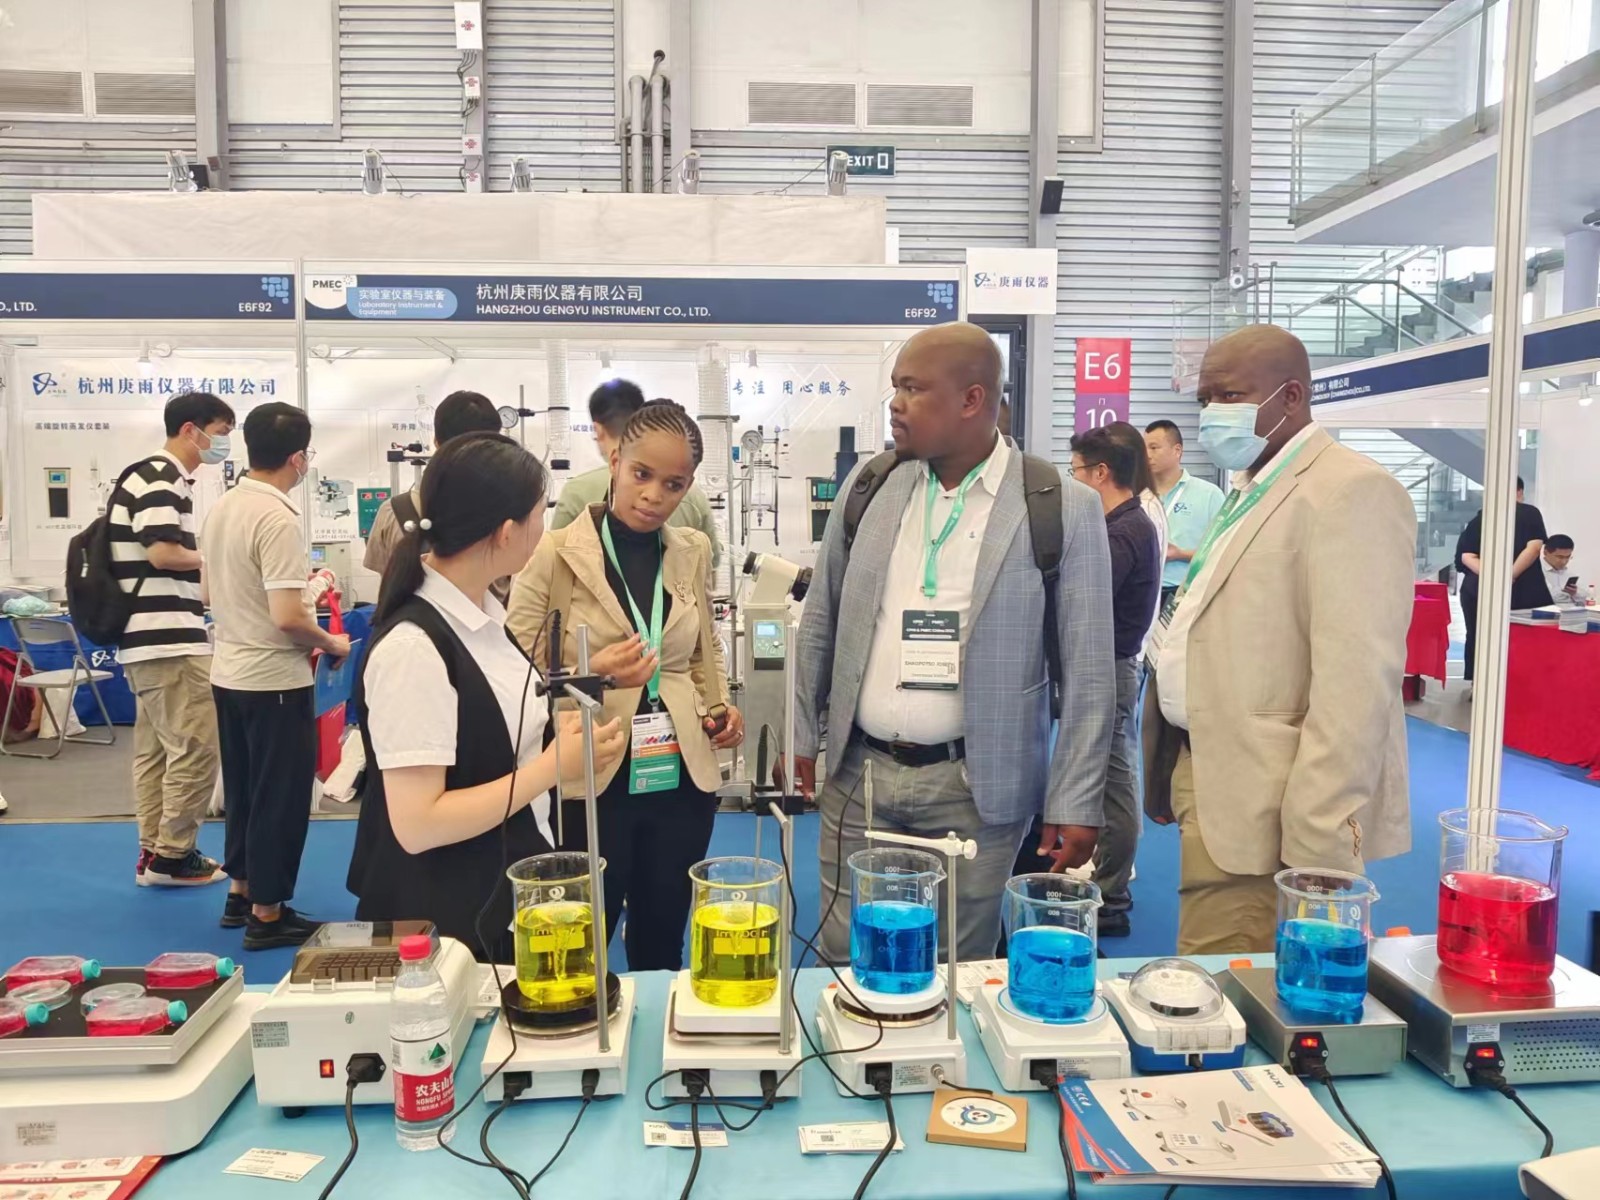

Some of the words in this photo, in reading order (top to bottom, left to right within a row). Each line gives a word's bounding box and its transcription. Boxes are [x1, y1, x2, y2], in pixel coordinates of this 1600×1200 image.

[847, 155, 874, 167] EXIT
[312, 280, 342, 289] PMEC
[999, 276, 1049, 288] 庚雨仪器
[358, 289, 445, 301] 实验室仪器与装备
[476, 283, 643, 302] 杭州庚雨仪器有限公司
[13, 301, 38, 312] LTD.
[238, 302, 272, 314] E6F92
[358, 302, 397, 310] Laboratory
[476, 304, 541, 315] HANGZHOU
[543, 305, 590, 316] GENGYU
[592, 305, 660, 316] INSTRUMENT
[663, 306, 687, 318] CO.,
[689, 306, 711, 317] LTD.
[904, 307, 937, 319] E6F92
[1084, 351, 1122, 380] E6
[77, 377, 276, 396] 杭州庚雨仪器有限公司
[732, 379, 766, 396] 专注
[782, 380, 852, 396] 用心服务
